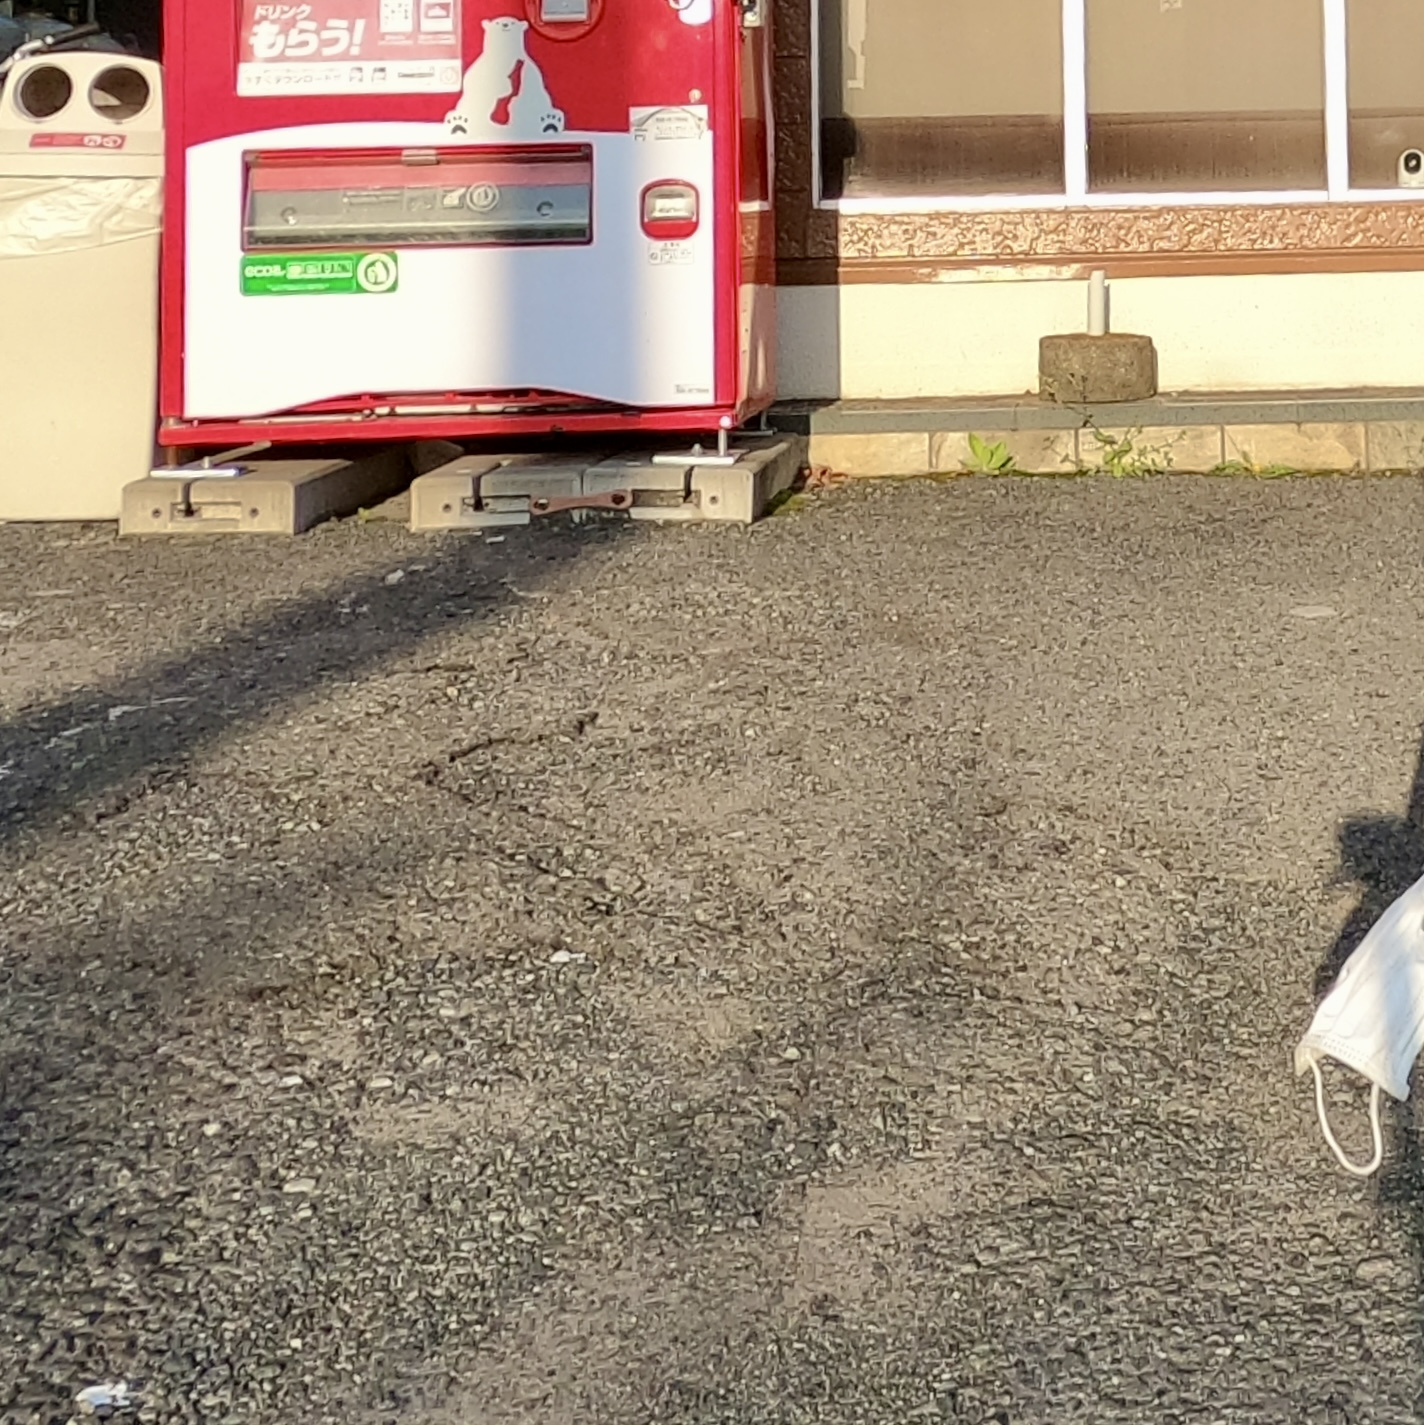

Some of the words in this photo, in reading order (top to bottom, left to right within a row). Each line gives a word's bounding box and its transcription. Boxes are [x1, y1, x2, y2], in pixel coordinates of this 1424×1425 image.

[253, 4, 312, 21] ドリンク
[248, 18, 366, 58] もらう!
